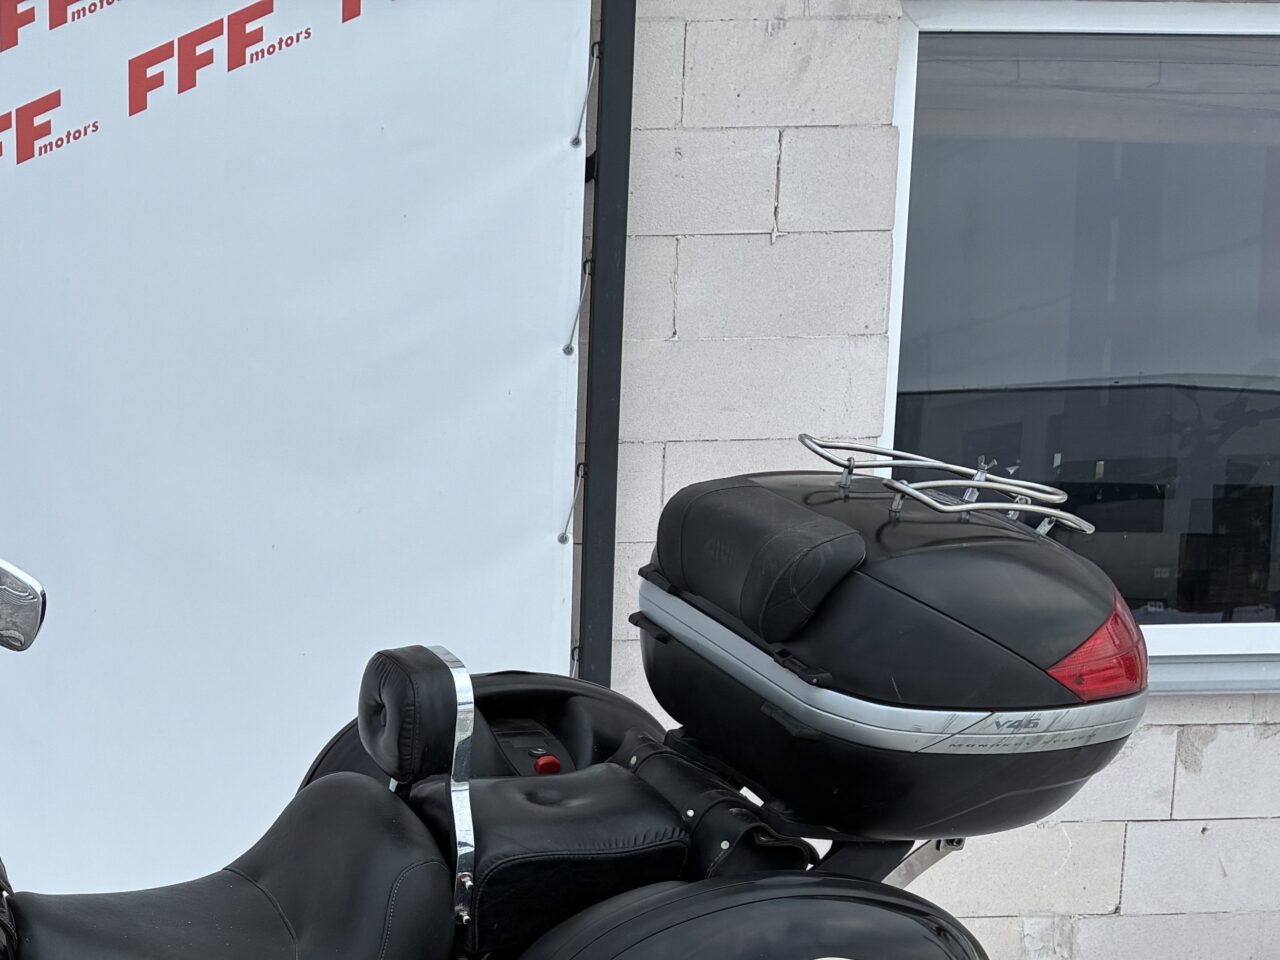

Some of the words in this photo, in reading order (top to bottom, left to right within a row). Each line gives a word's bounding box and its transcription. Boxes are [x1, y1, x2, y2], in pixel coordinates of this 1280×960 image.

[127, 0, 275, 117] FFF
[249, 27, 312, 64] motors
[38, 121, 100, 156] motors
